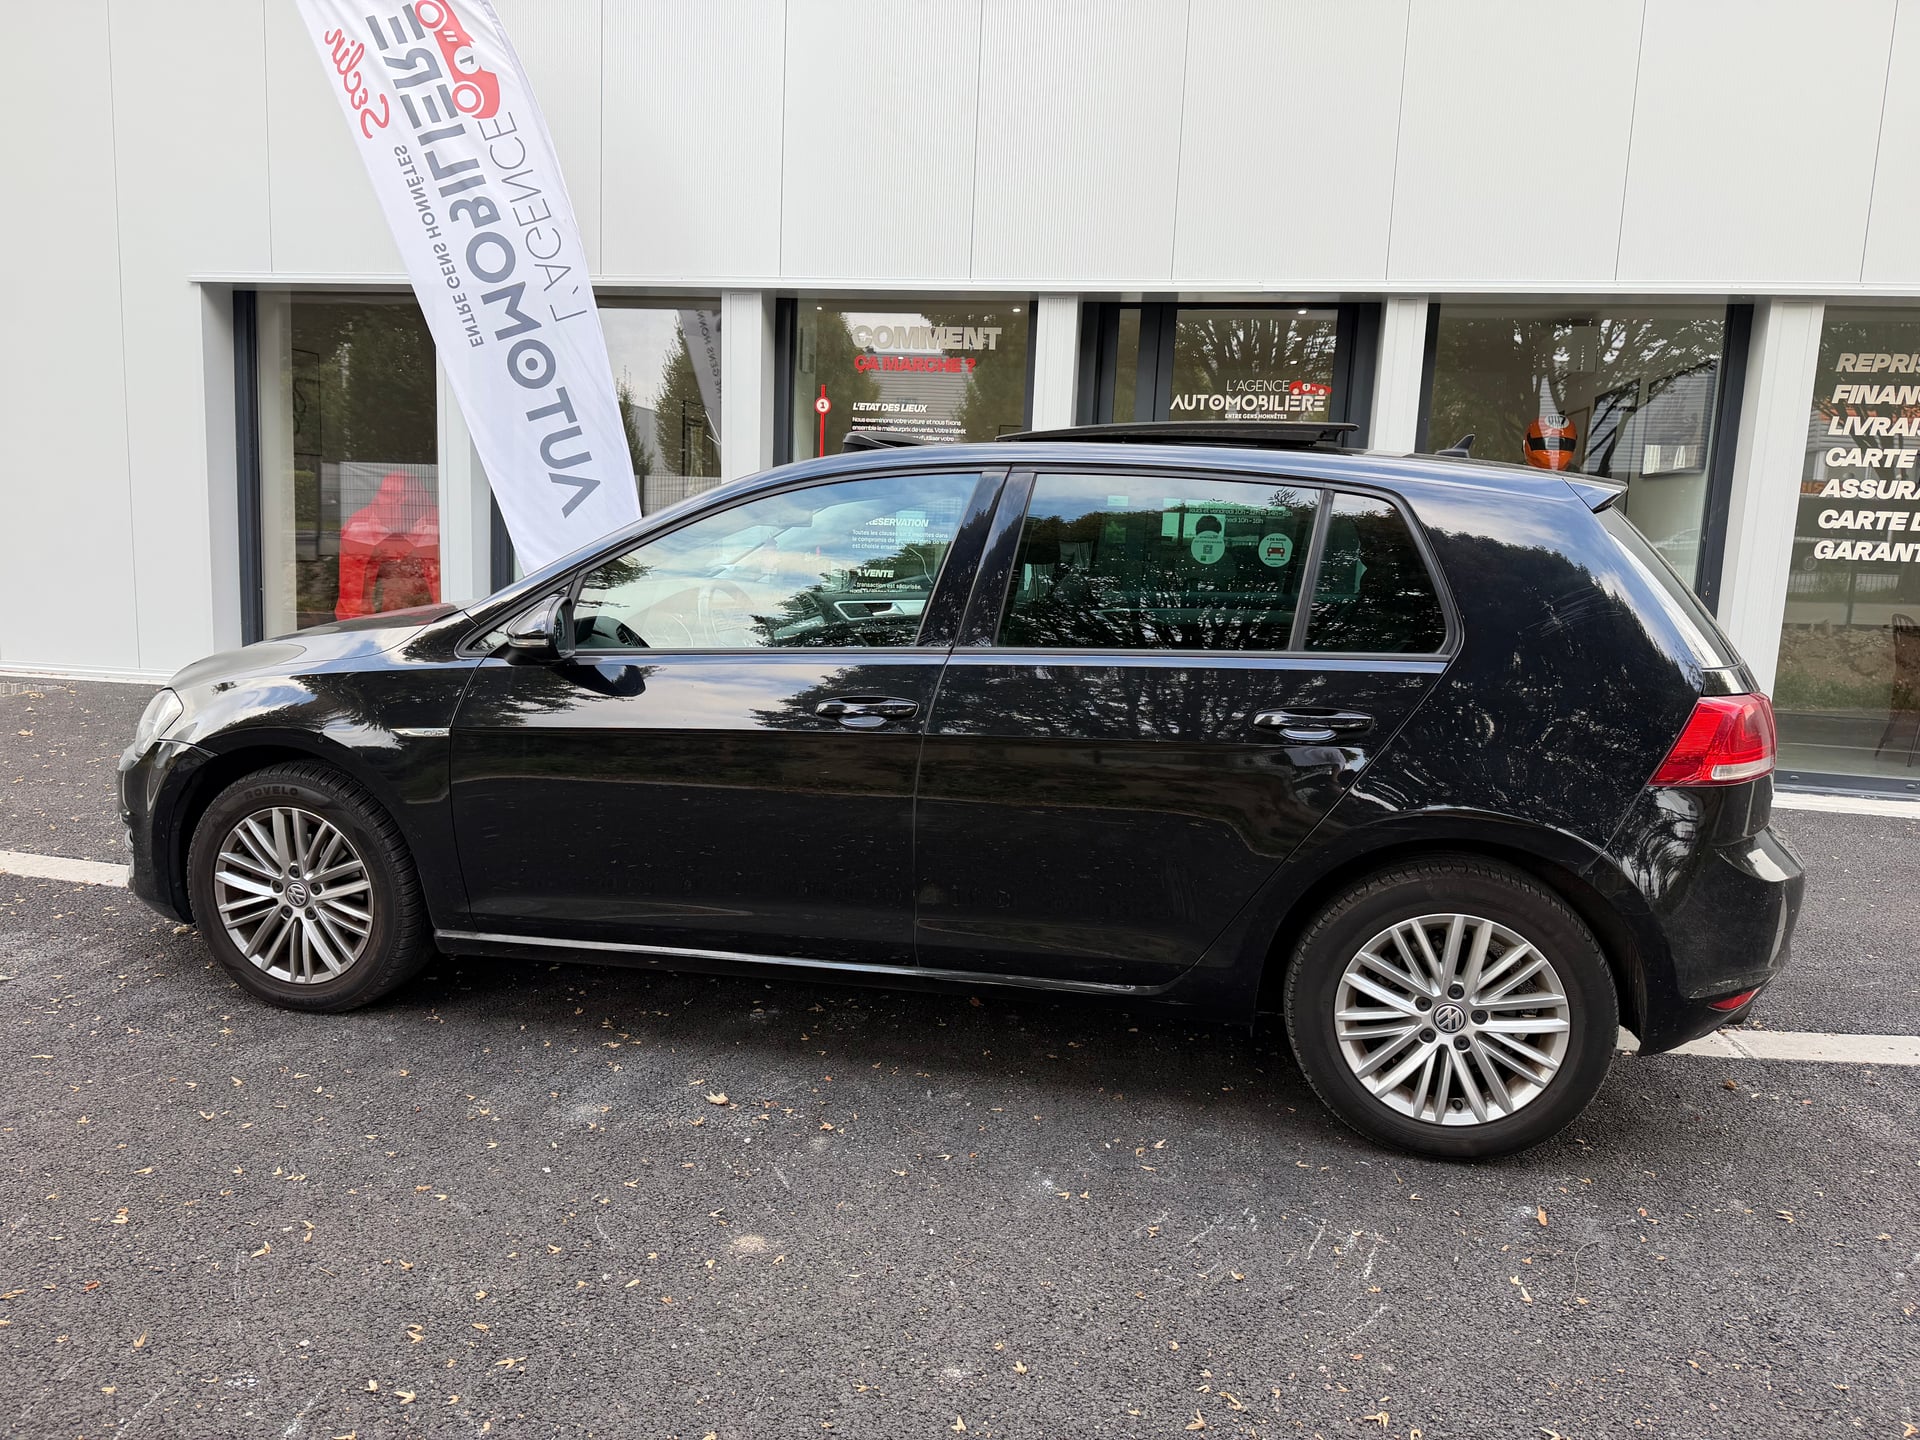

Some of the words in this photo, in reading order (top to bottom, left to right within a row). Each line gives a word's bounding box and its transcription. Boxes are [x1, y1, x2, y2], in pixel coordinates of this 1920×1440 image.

[852, 325, 1003, 350] COMMENT
[854, 355, 880, 374] ÇA
[883, 356, 961, 373] MARCHE
[961, 357, 976, 373] ?
[1835, 353, 1920, 373] REPRI
[1226, 379, 1290, 393] L'AGENCE
[1831, 385, 1920, 405] FINAN
[852, 402, 881, 412] L'ETAT
[881, 403, 900, 412] DES
[900, 403, 928, 413] LIEUX
[1827, 416, 1920, 437] LIVRAI
[1825, 447, 1918, 469] CARTE
[1817, 509, 1910, 531] CARTE
[864, 569, 895, 578] VENTE
